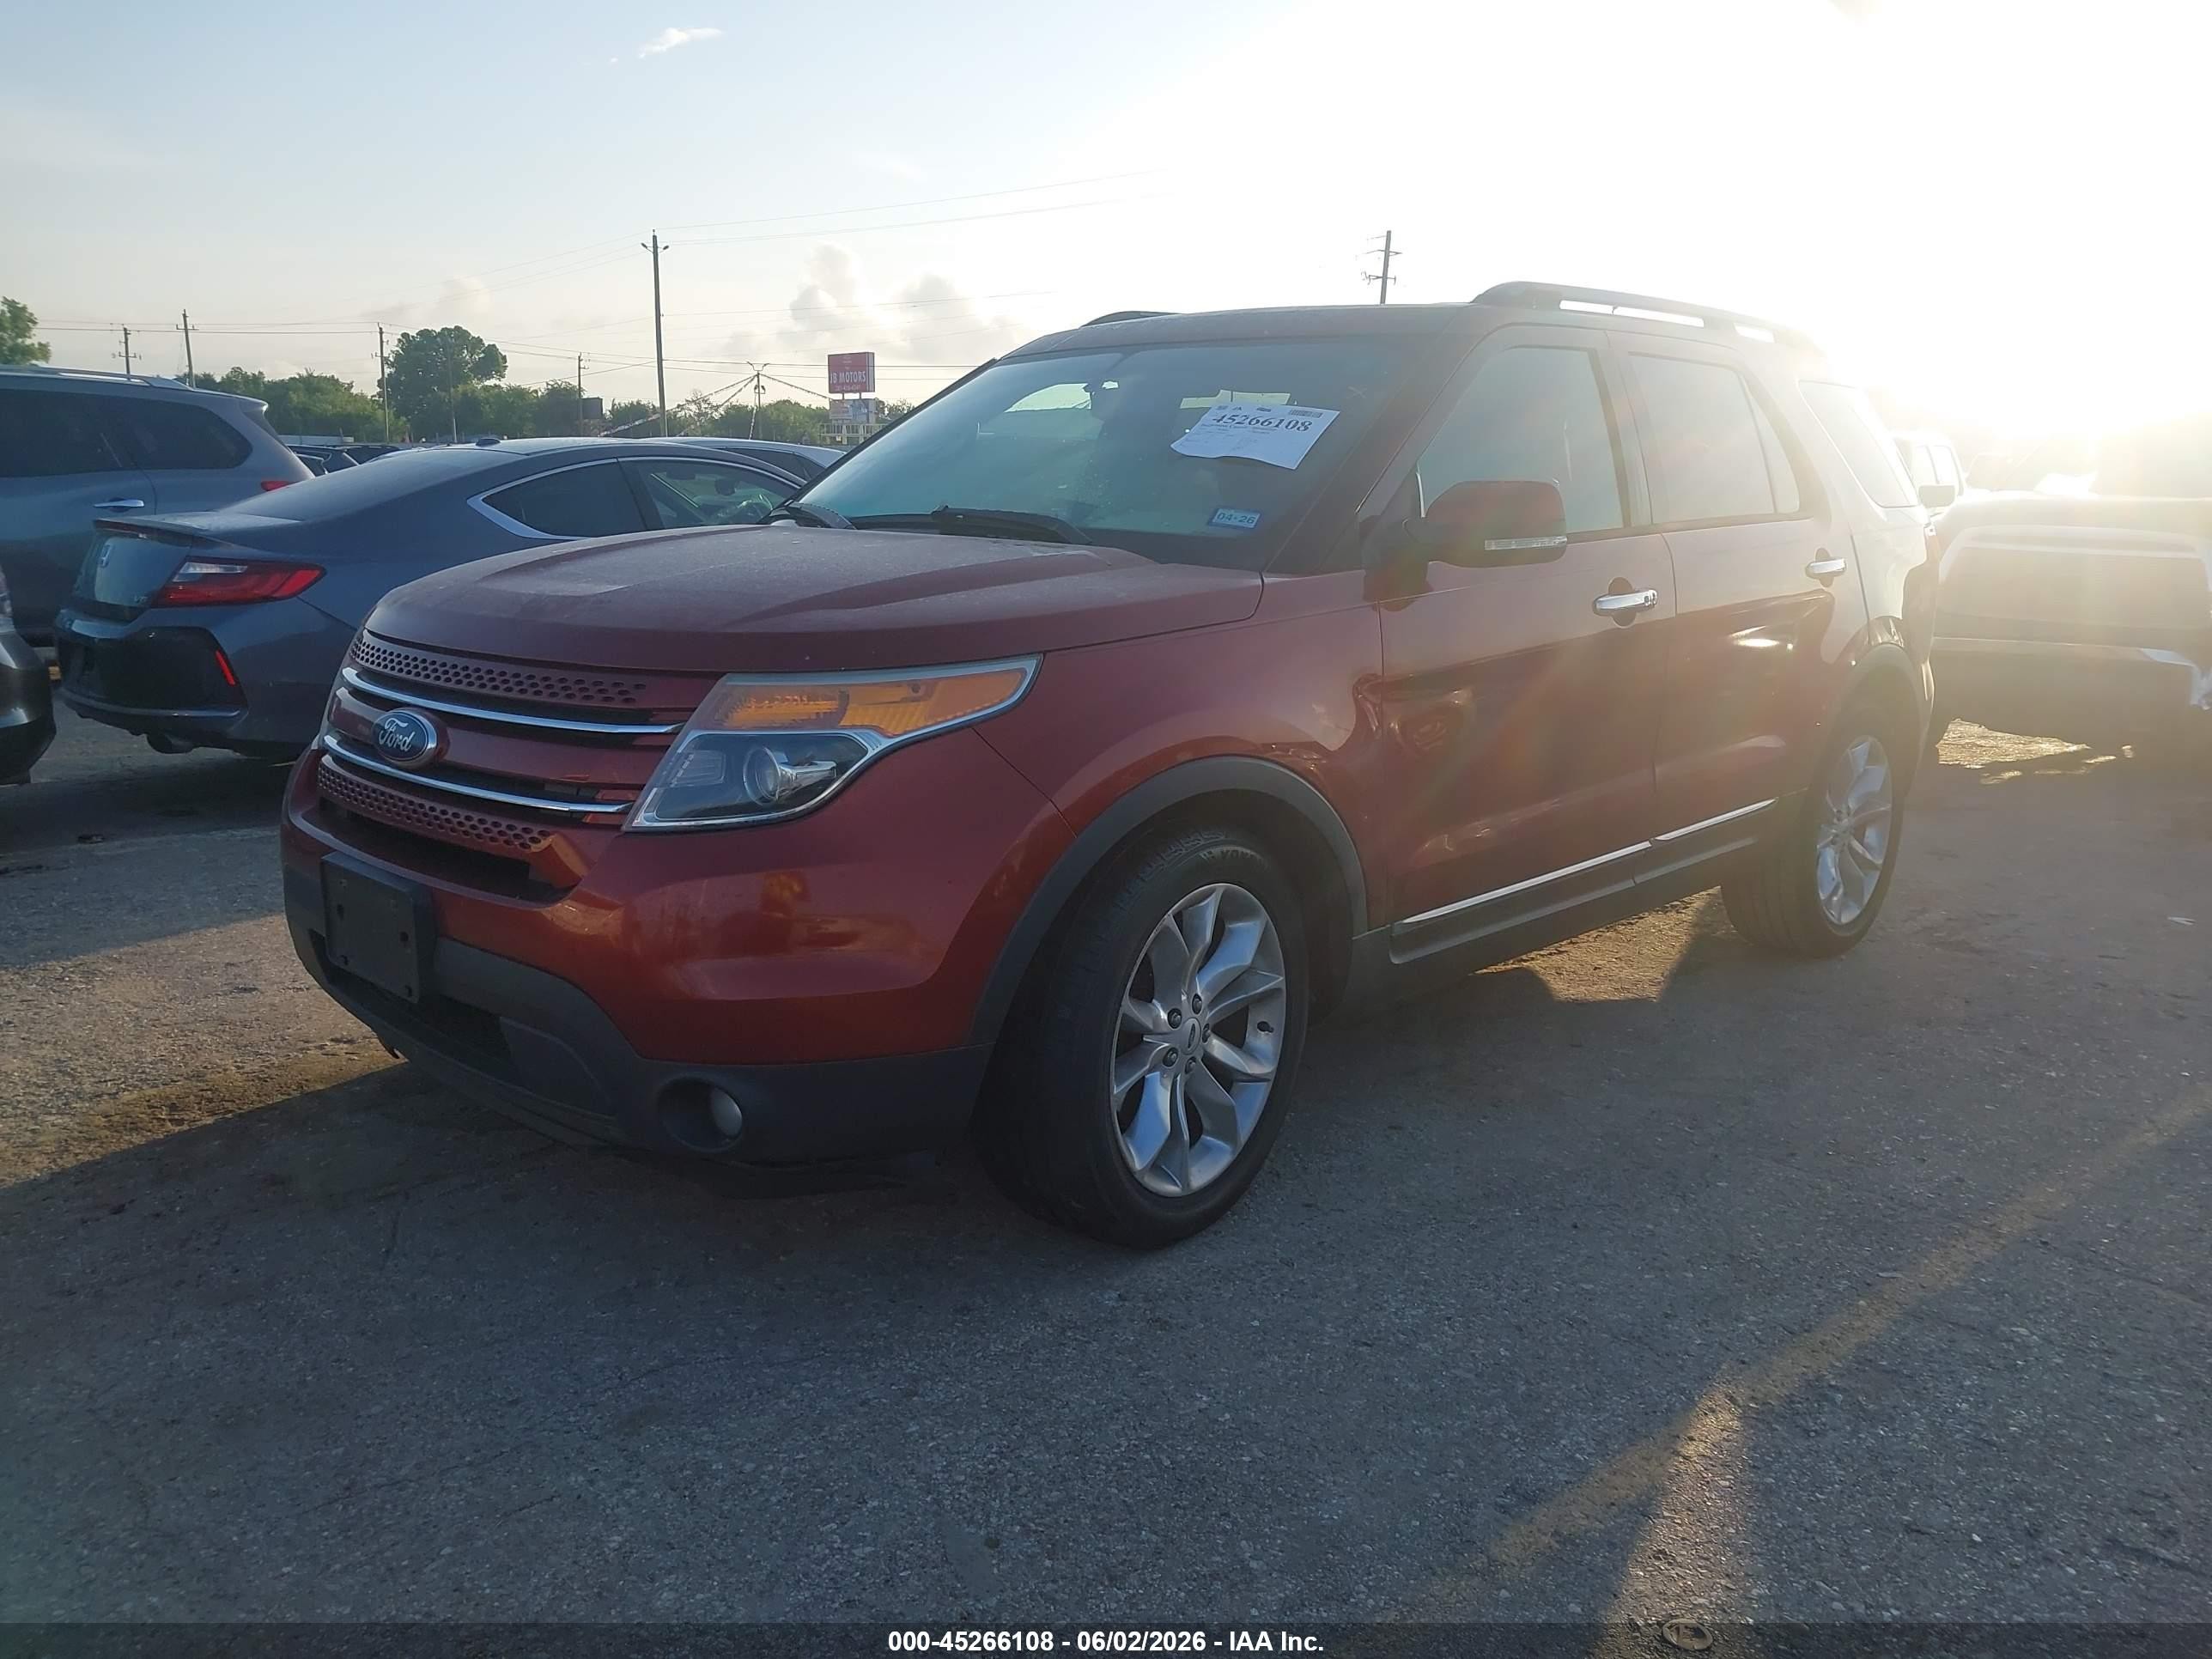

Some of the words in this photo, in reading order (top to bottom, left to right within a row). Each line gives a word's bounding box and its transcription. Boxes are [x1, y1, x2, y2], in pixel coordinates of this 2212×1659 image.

[839, 370, 866, 384] MOTORS
[1212, 413, 1313, 433] 45266108
[379, 717, 416, 752] Ford
